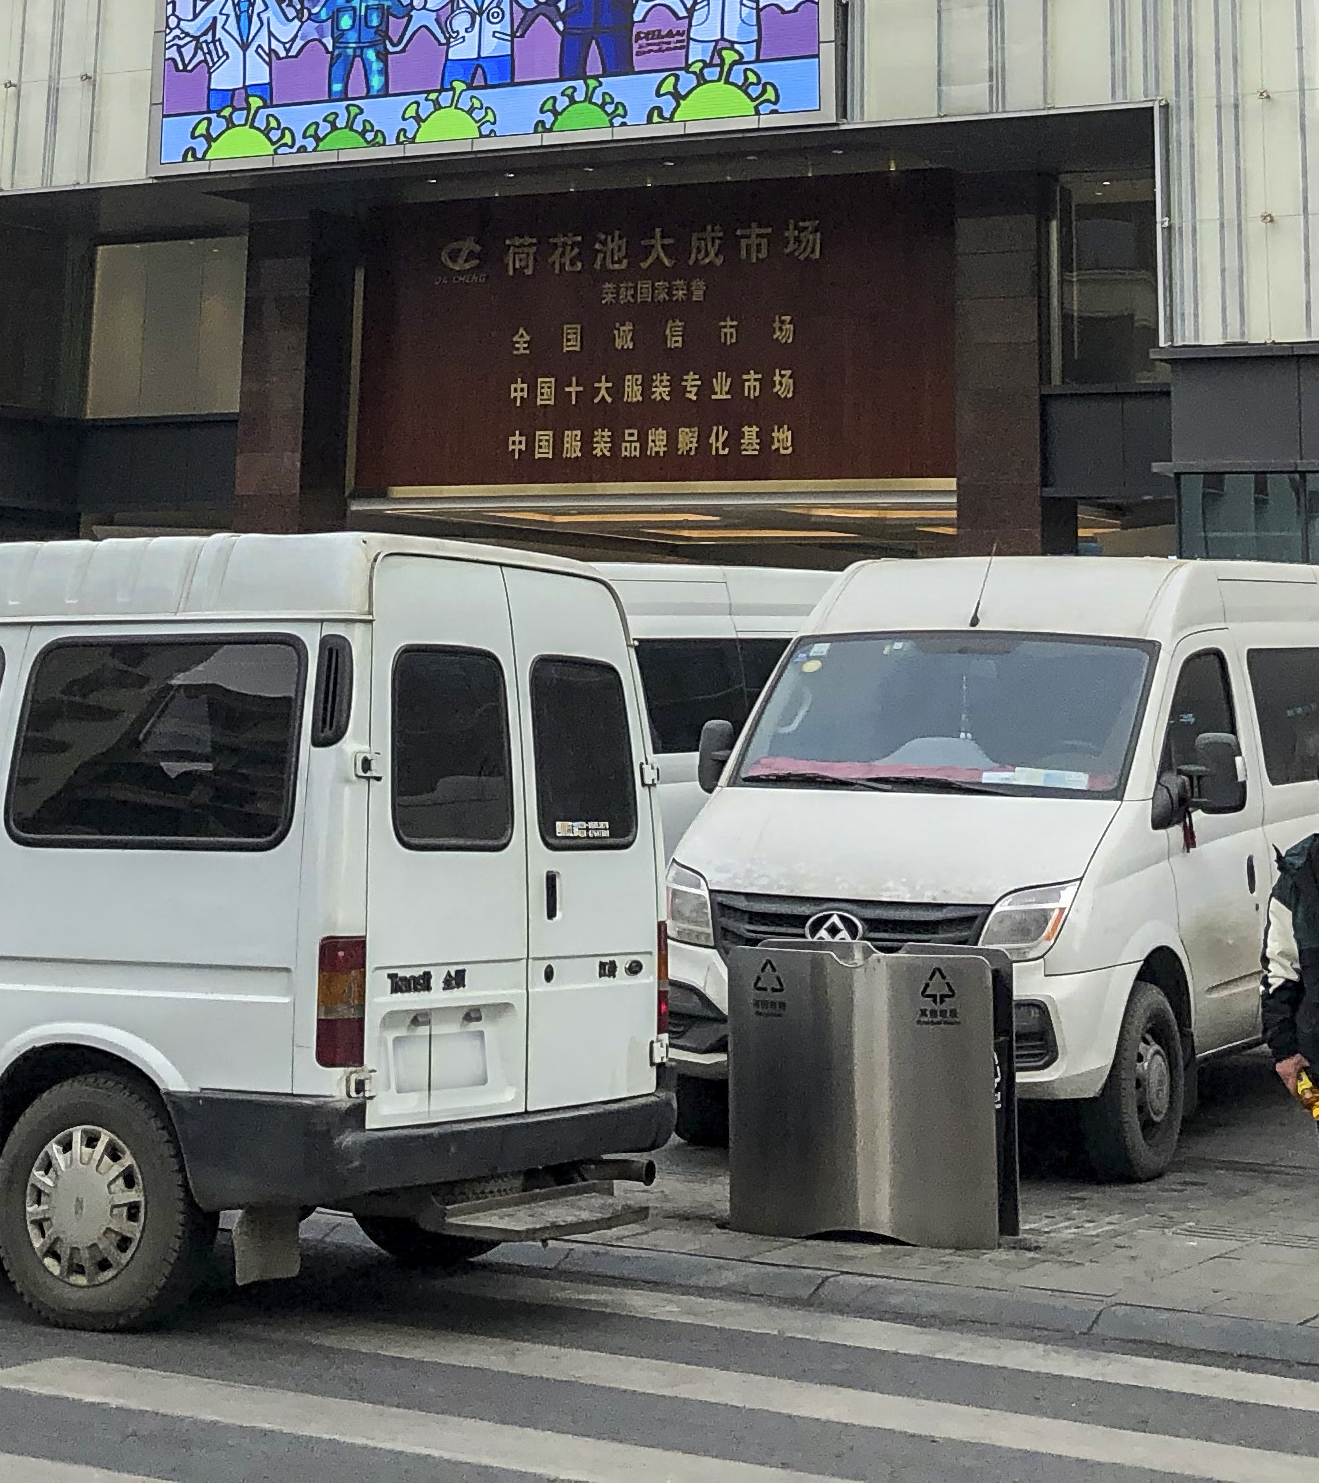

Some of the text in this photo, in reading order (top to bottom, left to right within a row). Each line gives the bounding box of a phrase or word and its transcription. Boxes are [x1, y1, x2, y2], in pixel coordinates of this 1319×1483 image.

[504, 219, 822, 277] 荷花池大成市场
[512, 315, 795, 356] 全国诚信市场
[510, 369, 795, 407] 中国十大服装专业市场
[508, 425, 793, 460] 中国服装品牌孵化基地
